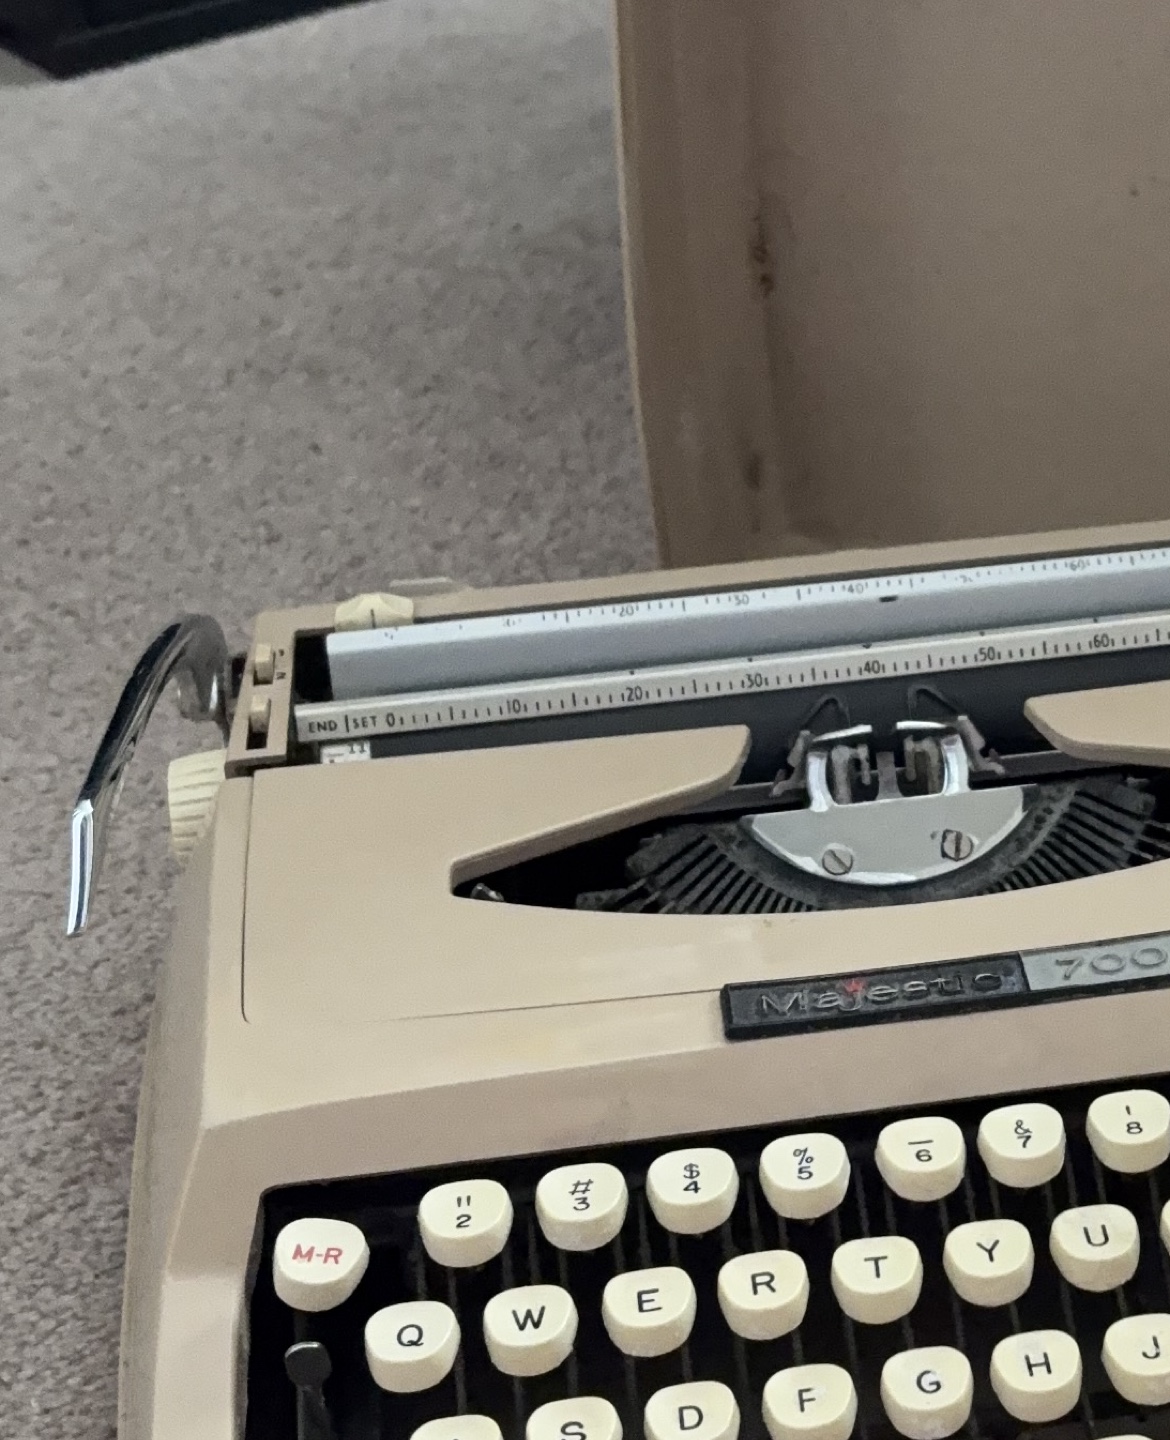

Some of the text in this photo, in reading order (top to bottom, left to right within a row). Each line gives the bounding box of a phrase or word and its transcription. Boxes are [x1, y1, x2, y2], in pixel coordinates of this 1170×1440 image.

[308, 719, 338, 734] END
[352, 714, 377, 731] SET
[385, 712, 396, 729] 0
[506, 697, 521, 715] 10
[626, 685, 643, 703] 20
[746, 672, 763, 690] 30
[863, 659, 881, 675] 40
[978, 646, 996, 662] 50
[1093, 632, 1111, 648] 60
[1055, 946, 1169, 982] 700
[455, 1214, 472, 1229] 2
[573, 1197, 590, 1211] 3
[683, 1180, 701, 1194] 4
[797, 1165, 813, 1180] 5
[915, 1149, 932, 1163] 6
[1016, 1134, 1032, 1149] 7
[1126, 1121, 1143, 1135] 8
[292, 1244, 343, 1265] M-R
[396, 1324, 424, 1347] Q
[512, 1306, 546, 1331] W
[636, 1287, 662, 1313] E
[751, 1271, 777, 1296] R
[864, 1255, 888, 1279] T
[976, 1239, 1000, 1263] Y
[1083, 1224, 1110, 1247] U
[678, 1405, 704, 1431] D
[797, 1387, 817, 1413] F
[916, 1370, 942, 1394] G
[1024, 1352, 1052, 1377] H
[1142, 1335, 1160, 1360] J
